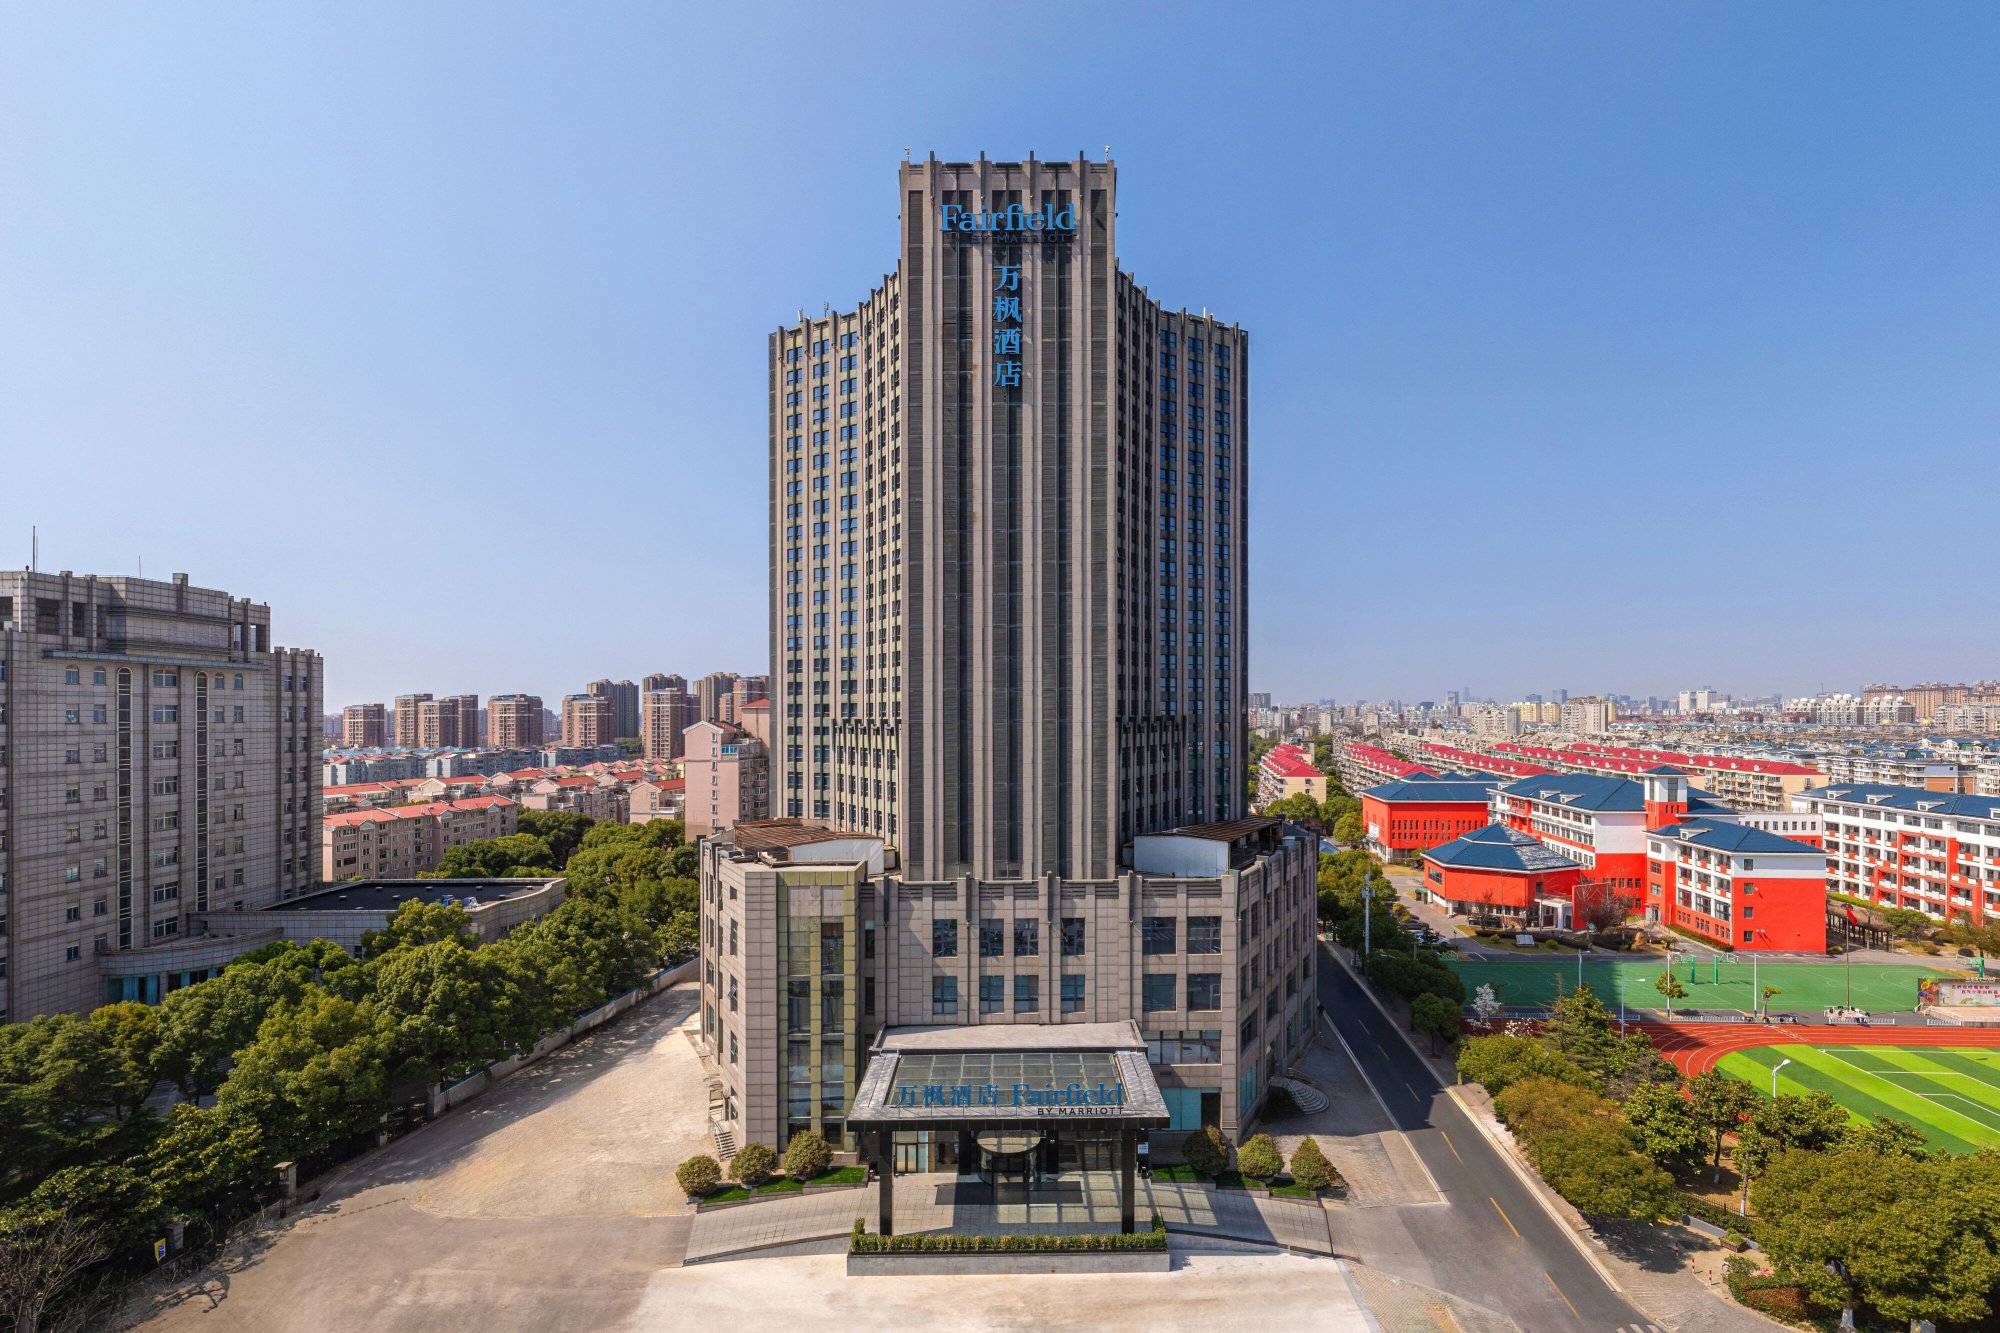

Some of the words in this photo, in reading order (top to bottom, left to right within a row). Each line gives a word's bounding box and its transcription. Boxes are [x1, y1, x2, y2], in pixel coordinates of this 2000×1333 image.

[940, 203, 1076, 231] Fairfield
[997, 234, 1077, 243] MARRIOTT
[992, 264, 1022, 387] 万枫酒店
[896, 1083, 999, 1107] 万枫酒店
[1011, 1082, 1123, 1105] Fairfield
[1037, 1107, 1053, 1115] BY
[1058, 1107, 1124, 1115] MARRIOTT
